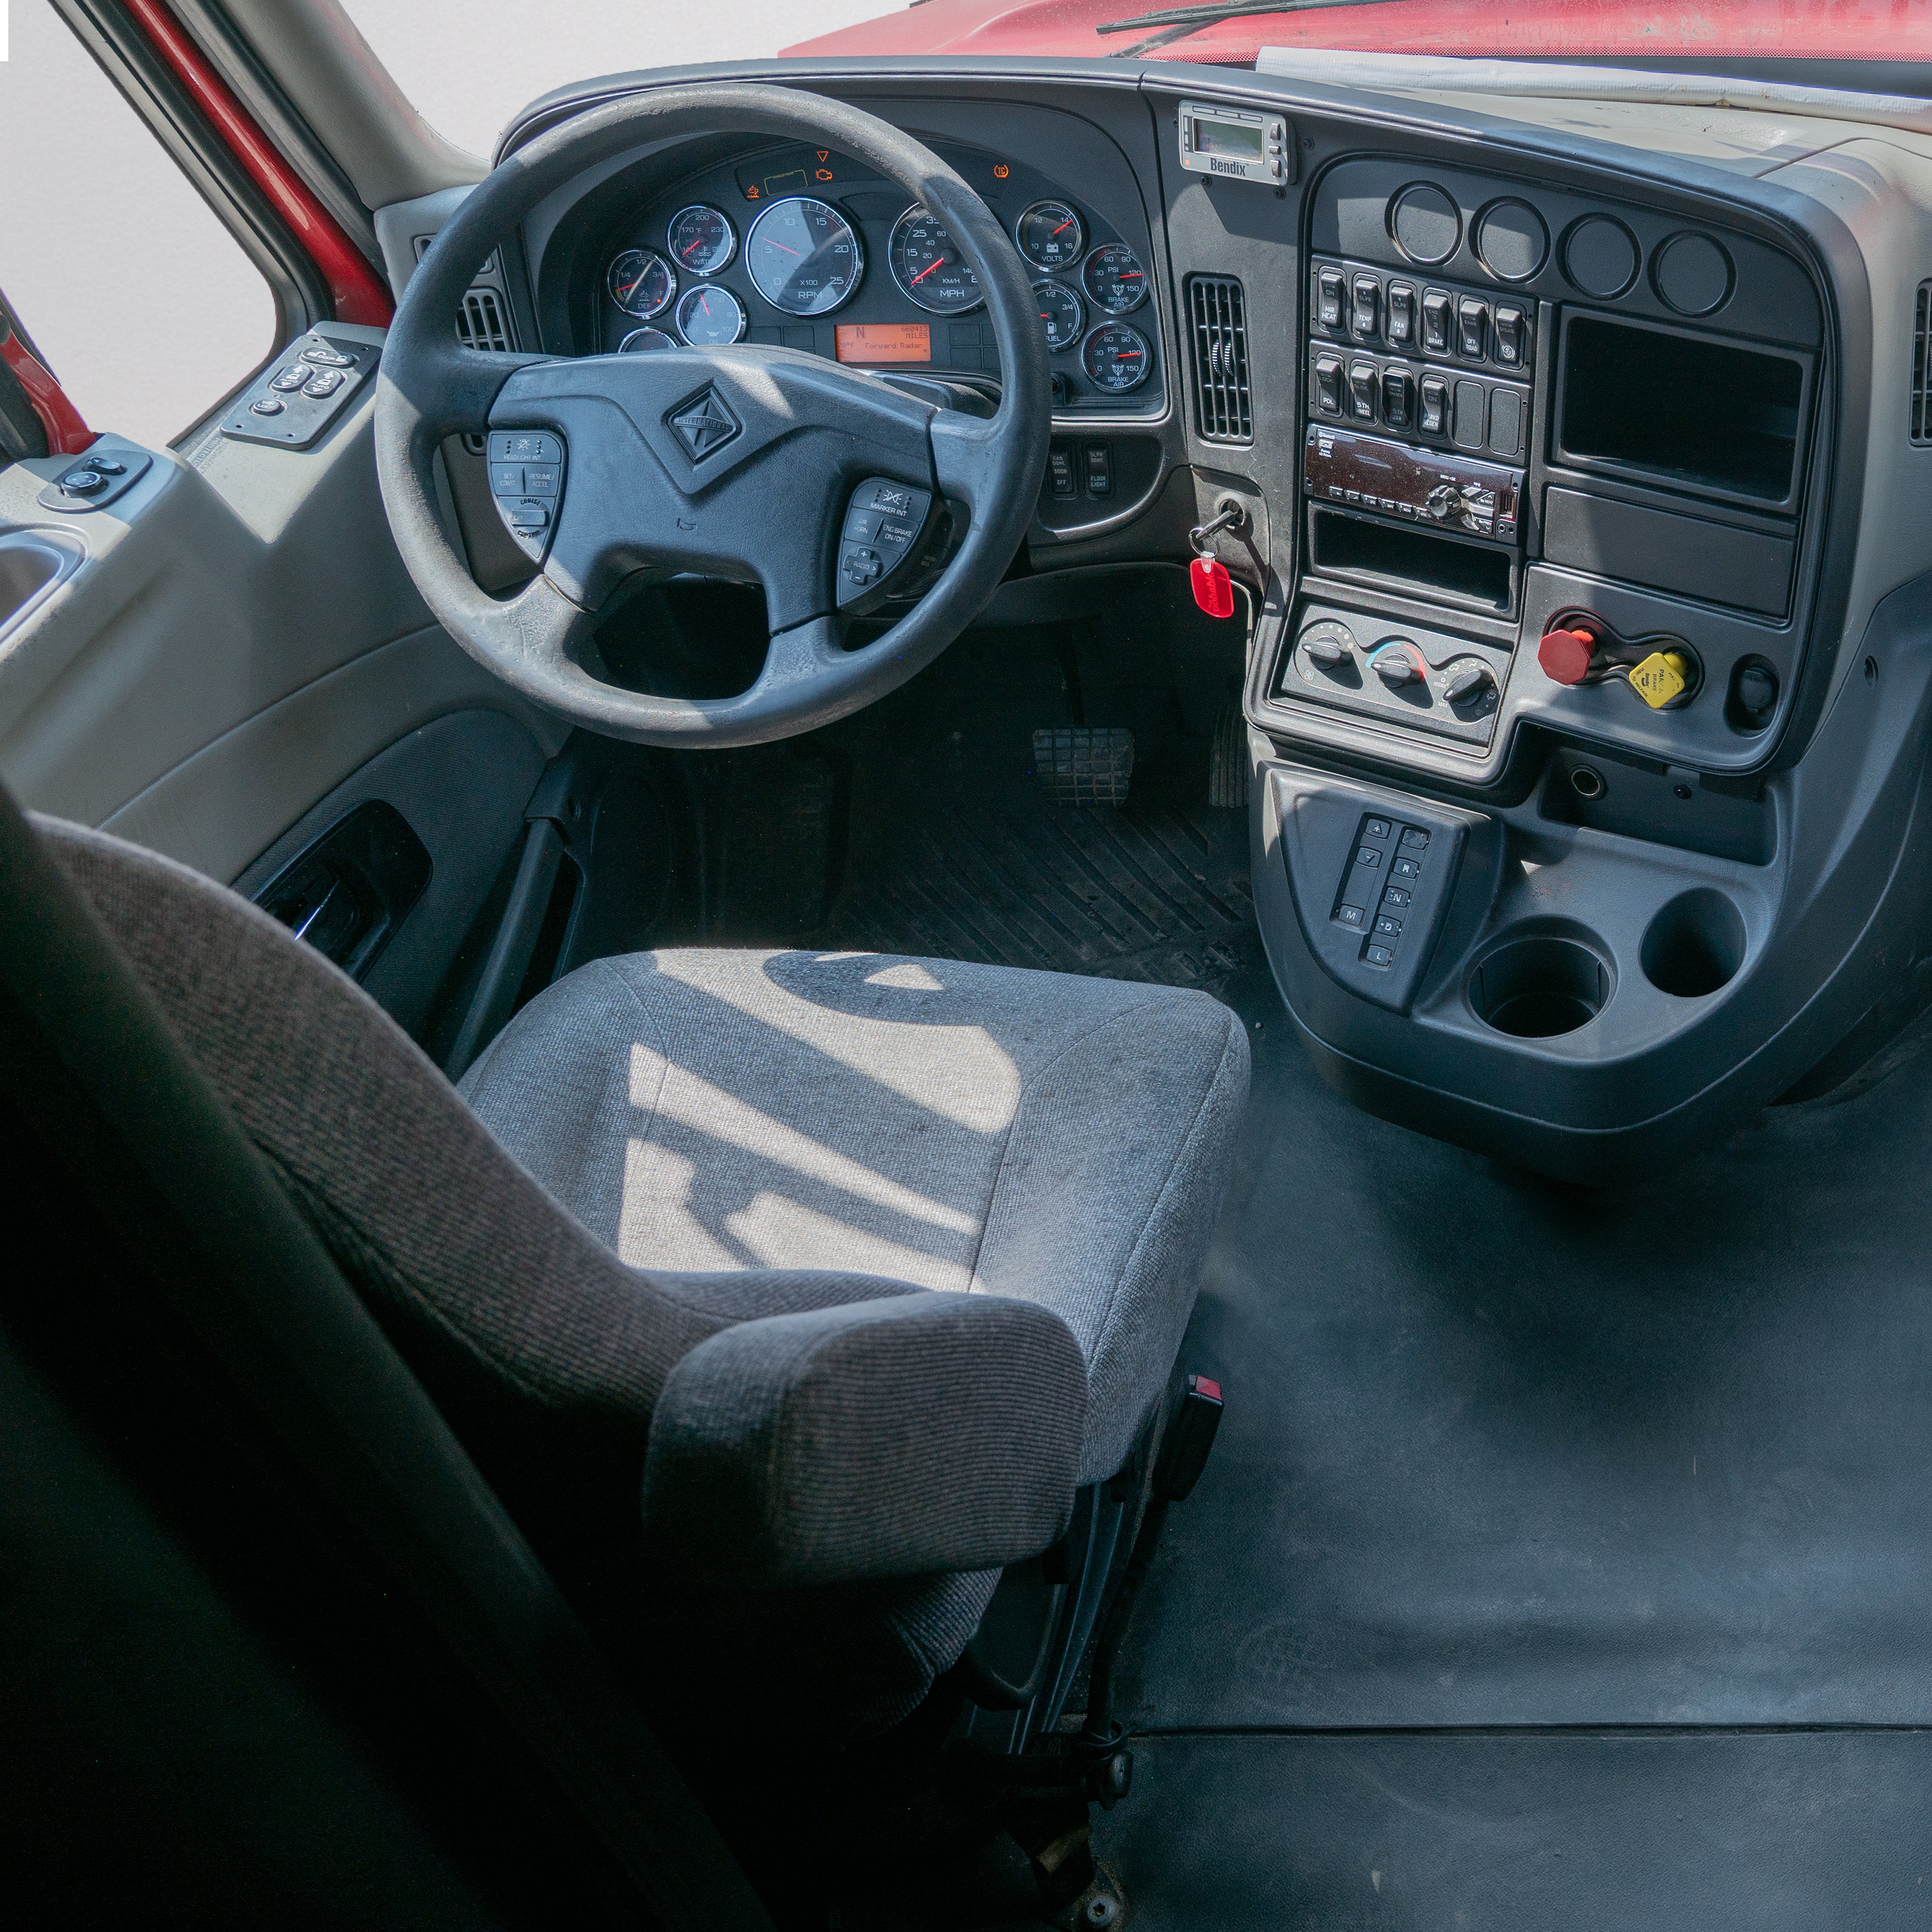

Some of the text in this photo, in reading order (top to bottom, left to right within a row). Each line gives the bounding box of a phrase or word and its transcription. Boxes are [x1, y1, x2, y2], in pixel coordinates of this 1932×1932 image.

[1211, 157, 1246, 176] Bendix
[910, 267, 917, 275] 5
[1322, 312, 1337, 320] HEAT
[856, 326, 865, 338] N
[1428, 337, 1443, 346] BRAKE
[1356, 408, 1371, 417] WHEEL
[678, 417, 729, 430] INTERNATIONAL
[1424, 419, 1439, 427] REGEN
[870, 502, 895, 514] MARKER
[883, 524, 913, 537] ENG BRAKE
[884, 533, 906, 543] ON/OFF
[853, 561, 870, 570] RADIO
[1635, 682, 1648, 698] RELEASE
[1402, 864, 1410, 873] R
[1393, 893, 1402, 902] N
[1346, 911, 1356, 920] M
[1384, 922, 1392, 931] D
[1376, 952, 1381, 960] L
